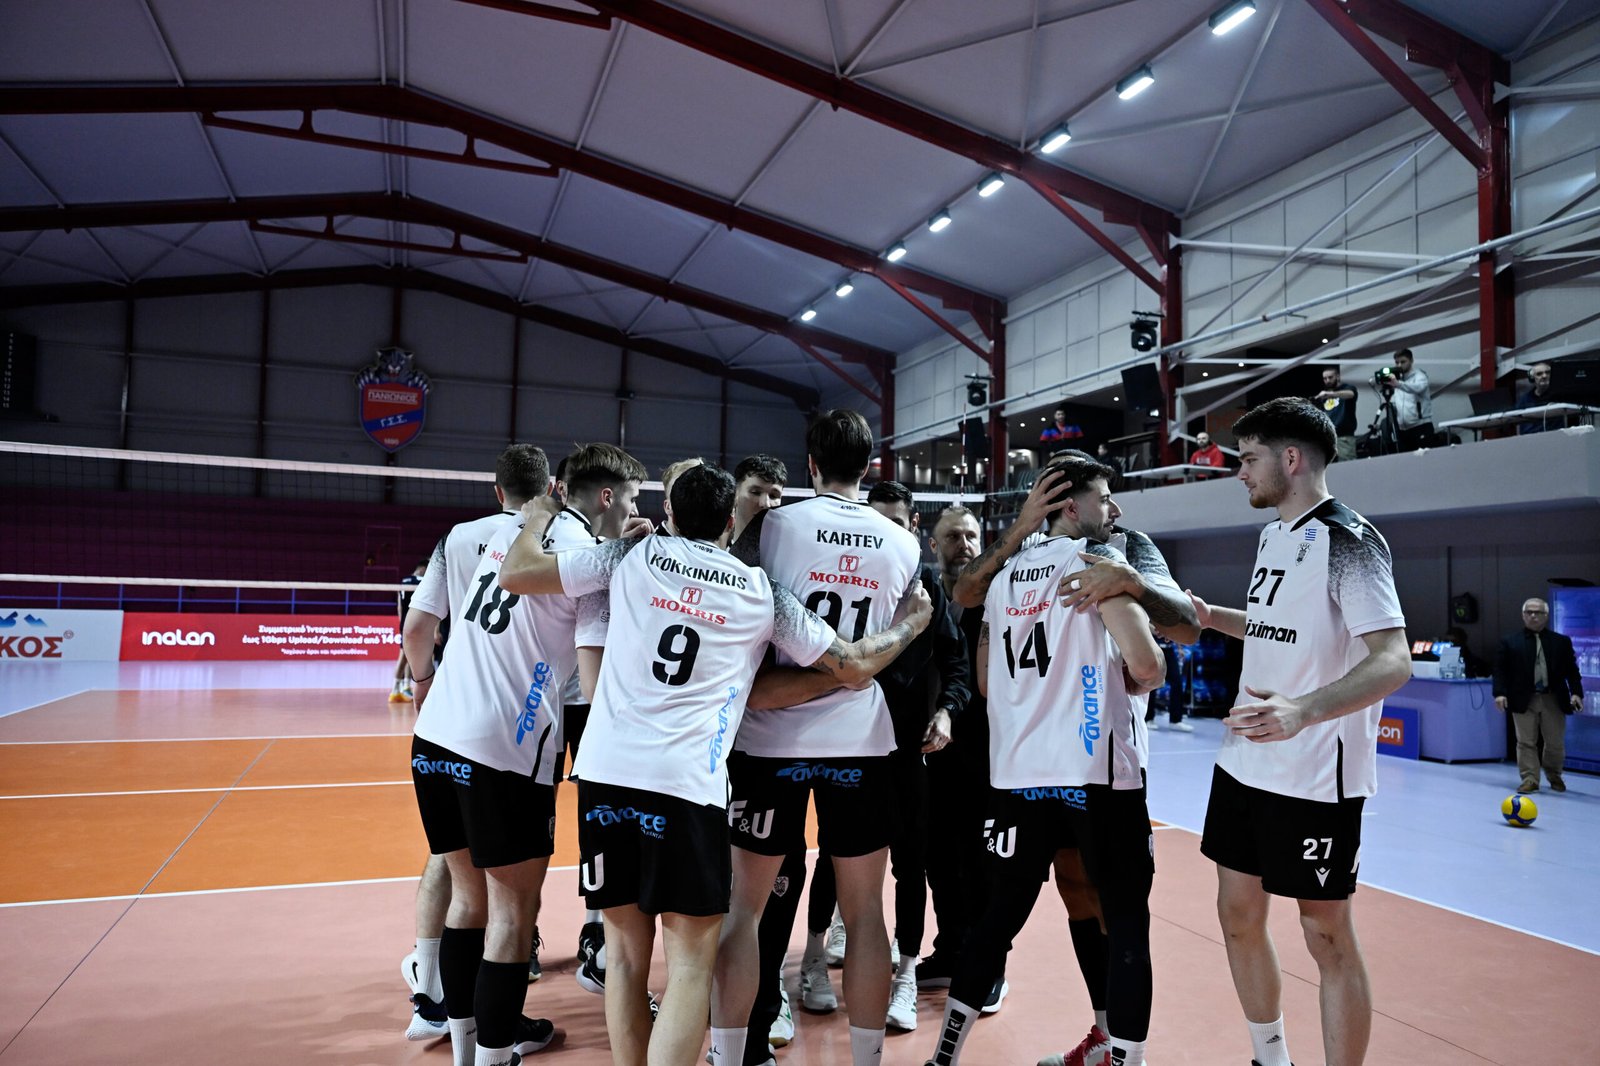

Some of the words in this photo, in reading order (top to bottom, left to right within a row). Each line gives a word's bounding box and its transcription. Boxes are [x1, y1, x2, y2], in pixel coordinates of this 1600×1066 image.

[817, 529, 883, 549] KARTEV
[650, 554, 747, 590] KOKKINAKIS
[809, 571, 879, 590] MORRIS
[1248, 567, 1286, 607] 27
[464, 571, 520, 634] 18
[650, 596, 727, 625] MORRIS
[1006, 601, 1050, 616] ORRIS
[0, 636, 63, 658] ΚΟΣ
[261, 635, 286, 645] 1Gbps
[288, 635, 363, 645] Upload/Download
[1003, 621, 1052, 678] 14
[652, 625, 701, 686] 9
[523, 661, 549, 732] avance
[1081, 664, 1101, 741] avance
[416, 760, 472, 779] avance
[791, 763, 863, 783] avance
[728, 799, 775, 839] F&U
[1303, 837, 1333, 860] 27
